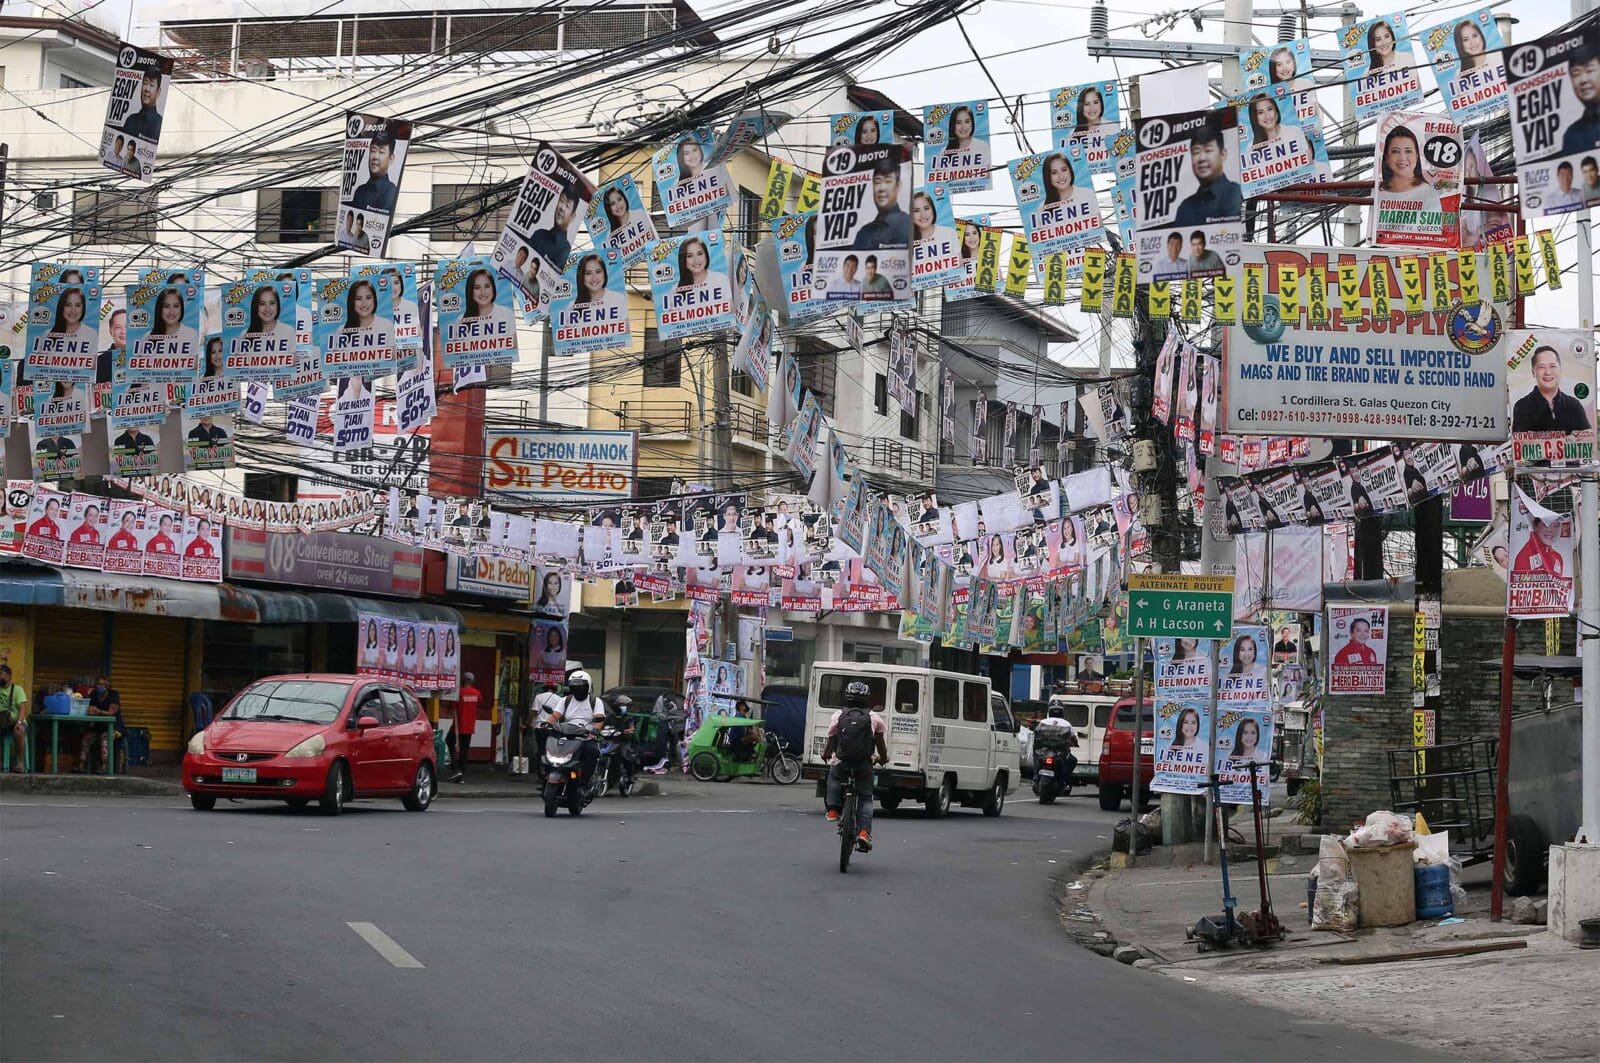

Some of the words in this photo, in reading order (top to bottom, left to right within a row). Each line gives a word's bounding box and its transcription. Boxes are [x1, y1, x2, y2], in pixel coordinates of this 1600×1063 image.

[1546, 36, 1583, 58] IBOTO!
[1512, 50, 1537, 75] #19
[116, 69, 144, 81] KONSEHAL
[1513, 68, 1567, 94] KONSEHAL
[112, 77, 138, 99] EGAY
[1517, 79, 1563, 122] EGAY
[109, 99, 129, 121] YAP
[364, 124, 386, 132] IBOTO!
[1142, 121, 1165, 145] #19
[1172, 117, 1206, 134] IBOTO!
[1424, 123, 1460, 134] RE-ELECT
[1523, 113, 1560, 153] YAP
[344, 149, 365, 171] EGAY
[539, 149, 555, 171] #19
[858, 151, 888, 163] IBOTO!
[1140, 144, 1188, 163] KONSEHAL
[1428, 142, 1458, 163] #18
[830, 152, 849, 171] #19
[556, 166, 577, 184] IBOTO!
[825, 174, 871, 187] KONSEHAL
[1140, 155, 1183, 191] EGAY
[342, 173, 357, 196] YAP
[530, 171, 562, 193] KONSEHAL
[1030, 184, 1037, 194] 5
[520, 180, 555, 211] EGAY
[822, 184, 867, 214] EGAY
[1143, 187, 1177, 220] YAP
[1380, 200, 1423, 210] COUNCILOR
[513, 206, 542, 230] YAP
[1379, 210, 1416, 224] MARRA
[1420, 211, 1456, 225] SUNTA
[824, 213, 857, 241] YAP
[792, 244, 799, 254] 5
[982, 233, 997, 284] LAGMAN
[1518, 243, 1534, 284] IVY
[665, 266, 671, 276] 5
[1086, 256, 1102, 299] IVY
[1462, 256, 1476, 296] IVY
[1493, 246, 1506, 295] LAGMAN
[1118, 260, 1133, 310] LAGMAN
[1373, 263, 1385, 314] LAGMAN
[1405, 263, 1420, 304] IVY
[1433, 257, 1448, 306] LAGMAN
[1248, 269, 1258, 320] LAGMAN
[1281, 272, 1295, 312] IVY
[1311, 269, 1323, 320] LAGMAN
[1342, 269, 1358, 316] IVY
[560, 308, 619, 325] IRENE
[1293, 306, 1348, 331] TIRE
[1355, 309, 1446, 335] SUPPLY
[448, 322, 507, 339] IRENE
[34, 338, 90, 354] IRENE
[134, 340, 190, 354] IRENE
[231, 339, 288, 353] IRENE
[329, 333, 386, 348] IRENE
[326, 349, 391, 364] BELMONTE
[1267, 345, 1289, 362] WE
[1295, 346, 1322, 364] BUY
[1330, 347, 1360, 365] AND
[1366, 349, 1395, 366] SELL
[1401, 350, 1471, 368] IMPORTED
[1507, 334, 1538, 370] RE-ELECT
[29, 355, 93, 368] BELMONTE
[130, 356, 194, 369] BELMONTE
[228, 355, 292, 367] BELMONTE
[1241, 364, 1272, 380] MAGS
[1277, 366, 1301, 381] AND
[1306, 366, 1328, 381] TIRE
[1332, 367, 1369, 383] BRAND
[1374, 368, 1399, 384] NEW
[1405, 369, 1414, 385] &
[1419, 371, 1460, 386] SECOND
[1465, 372, 1495, 388] HAND
[192, 383, 233, 395] IRENE
[118, 392, 159, 404] IRENE
[189, 393, 237, 406] BELMONTE
[338, 401, 351, 410] VICE
[351, 399, 371, 410] MAYOR
[1281, 396, 1286, 404] 1
[1290, 396, 1340, 407] Cordillera
[1343, 397, 1356, 407] St.
[1360, 397, 1387, 408] Galas
[1391, 399, 1428, 411] Quezon
[1432, 399, 1450, 411] City
[41, 402, 80, 414] IRENE
[115, 405, 162, 416] BELMONTE
[38, 414, 84, 425] BELMONTE
[344, 414, 363, 426] GIAN
[1238, 409, 1258, 421] Cel:
[1407, 414, 1427, 426] Tel:
[1430, 415, 1495, 429] 8-292-71-21
[337, 427, 369, 446] SOTTO
[522, 443, 575, 460] LECHON
[580, 443, 628, 460] MANOK
[1514, 442, 1542, 460] BONG
[1544, 442, 1556, 459] C.
[1556, 442, 1592, 460] SUNTAY
[351, 465, 373, 474] BIG
[489, 437, 532, 487] Sr.
[542, 462, 627, 490] Pedro
[1016, 477, 1029, 488] EGAY
[907, 503, 921, 515] EGAY
[910, 512, 920, 522] YAP
[270, 535, 295, 572] 08
[297, 539, 359, 563] Convenience
[364, 546, 390, 567] Store
[317, 569, 334, 579] OPEN
[336, 571, 348, 583] 24
[349, 574, 368, 585] HOURS
[498, 566, 529, 585] Pedro
[1140, 581, 1188, 589] ALTERNATE
[732, 595, 741, 604] JOY
[742, 596, 768, 606] BELMONTE
[782, 601, 793, 611] JOY
[794, 602, 821, 611] BELMONTE
[1163, 599, 1170, 609] G
[1176, 600, 1225, 611] Araneta
[1136, 617, 1143, 628] A
[1150, 618, 1156, 628] H
[1163, 618, 1204, 630] Lacson
[1371, 613, 1384, 627] #4
[1161, 664, 1205, 676] IRENE
[1415, 654, 1424, 688] LAGMAN
[1158, 677, 1209, 688] BELMONTE
[1218, 679, 1263, 689] IRENE
[1331, 676, 1351, 686] HERO
[1352, 676, 1383, 686] BAUTISTA
[1217, 691, 1267, 701] BELMONTE
[1156, 764, 1206, 774] BELMONTE
